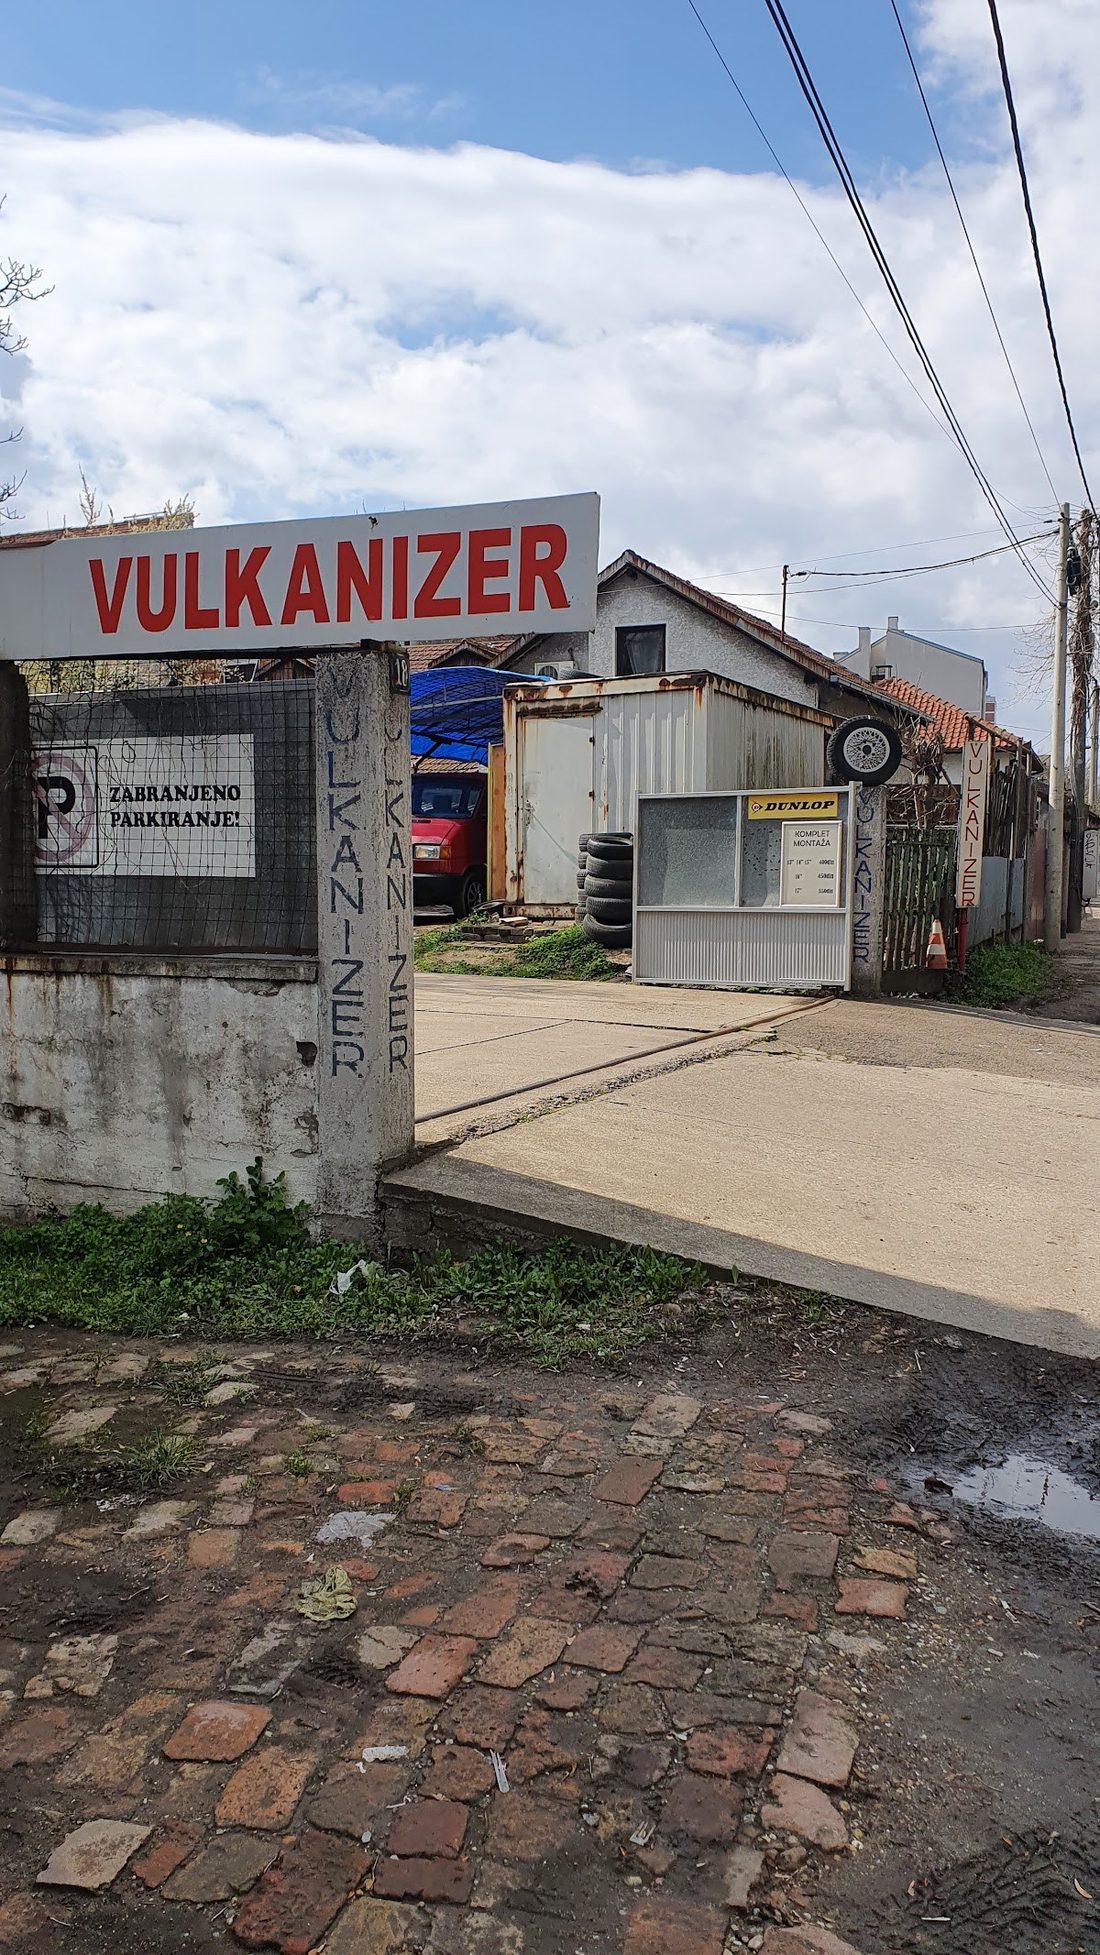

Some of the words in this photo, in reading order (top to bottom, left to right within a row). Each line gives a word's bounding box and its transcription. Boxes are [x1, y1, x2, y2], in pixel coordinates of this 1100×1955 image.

[89, 523, 571, 635] VULKANIZER
[394, 657, 408, 687] 18
[109, 785, 241, 803] ZABRANJENO
[764, 800, 835, 811] DUNLOP
[109, 811, 240, 828] PARKIRANJE!
[961, 742, 983, 907] VULKANIZER
[793, 838, 831, 847] MONTAŽA
[794, 830, 831, 838] KOMPLET
[853, 791, 875, 963] VULKANIZER
[383, 708, 409, 1075] ULKANIZER
